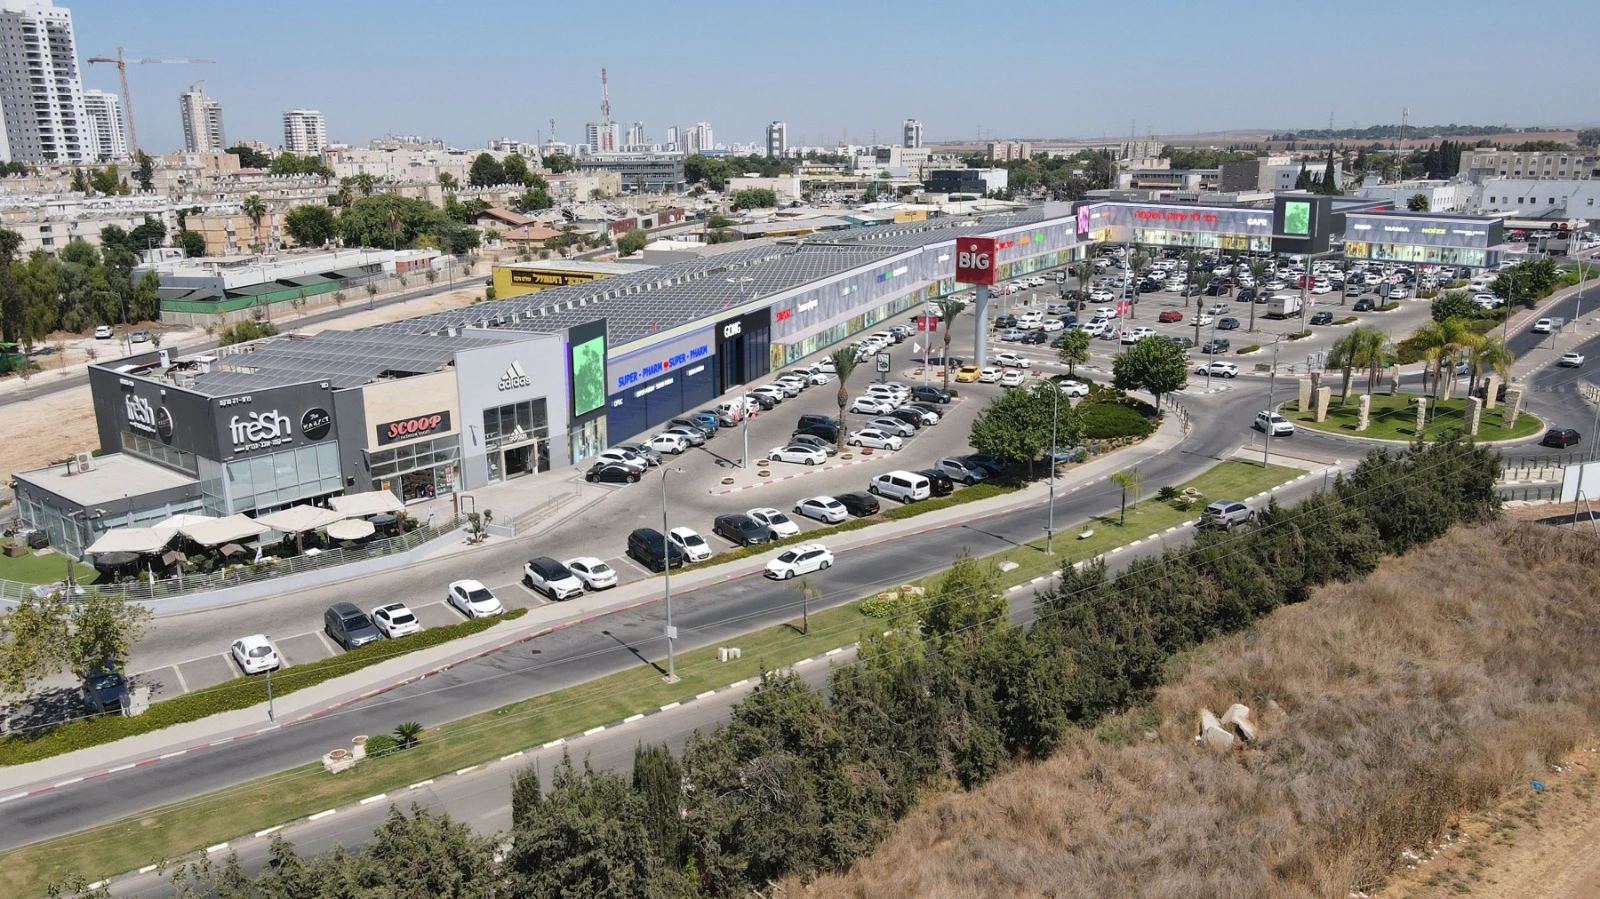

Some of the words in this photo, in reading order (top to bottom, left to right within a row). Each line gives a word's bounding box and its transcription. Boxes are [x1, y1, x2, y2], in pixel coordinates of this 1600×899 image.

[1190, 211, 1201, 221] לוי
[1203, 213, 1218, 223] רמי
[669, 353, 686, 368] SUPER
[690, 344, 708, 359] PHARM
[498, 376, 532, 391] adidas
[617, 371, 638, 387] SUPER
[643, 362, 662, 378] PHARM
[387, 414, 442, 438] SCOOP
